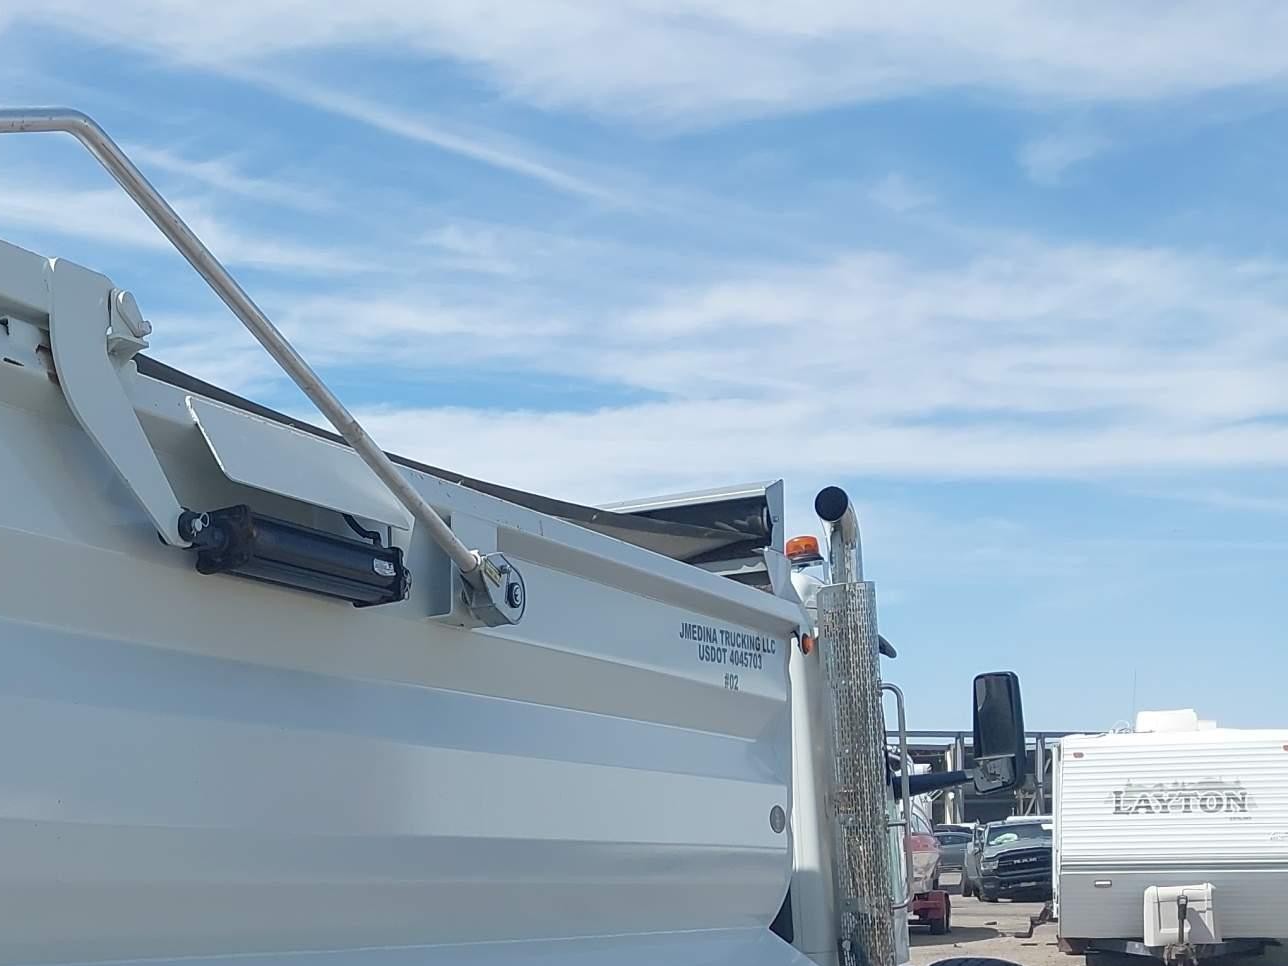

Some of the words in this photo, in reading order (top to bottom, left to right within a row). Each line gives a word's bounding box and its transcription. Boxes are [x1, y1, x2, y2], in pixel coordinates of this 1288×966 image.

[679, 622, 718, 644] JMEDINA
[720, 629, 761, 651] TRUCKING
[762, 637, 776, 654] LLC
[698, 644, 728, 664] USDOT
[729, 650, 763, 670] 4045703
[724, 672, 739, 690] #02
[1112, 790, 1249, 816] LAYTON
